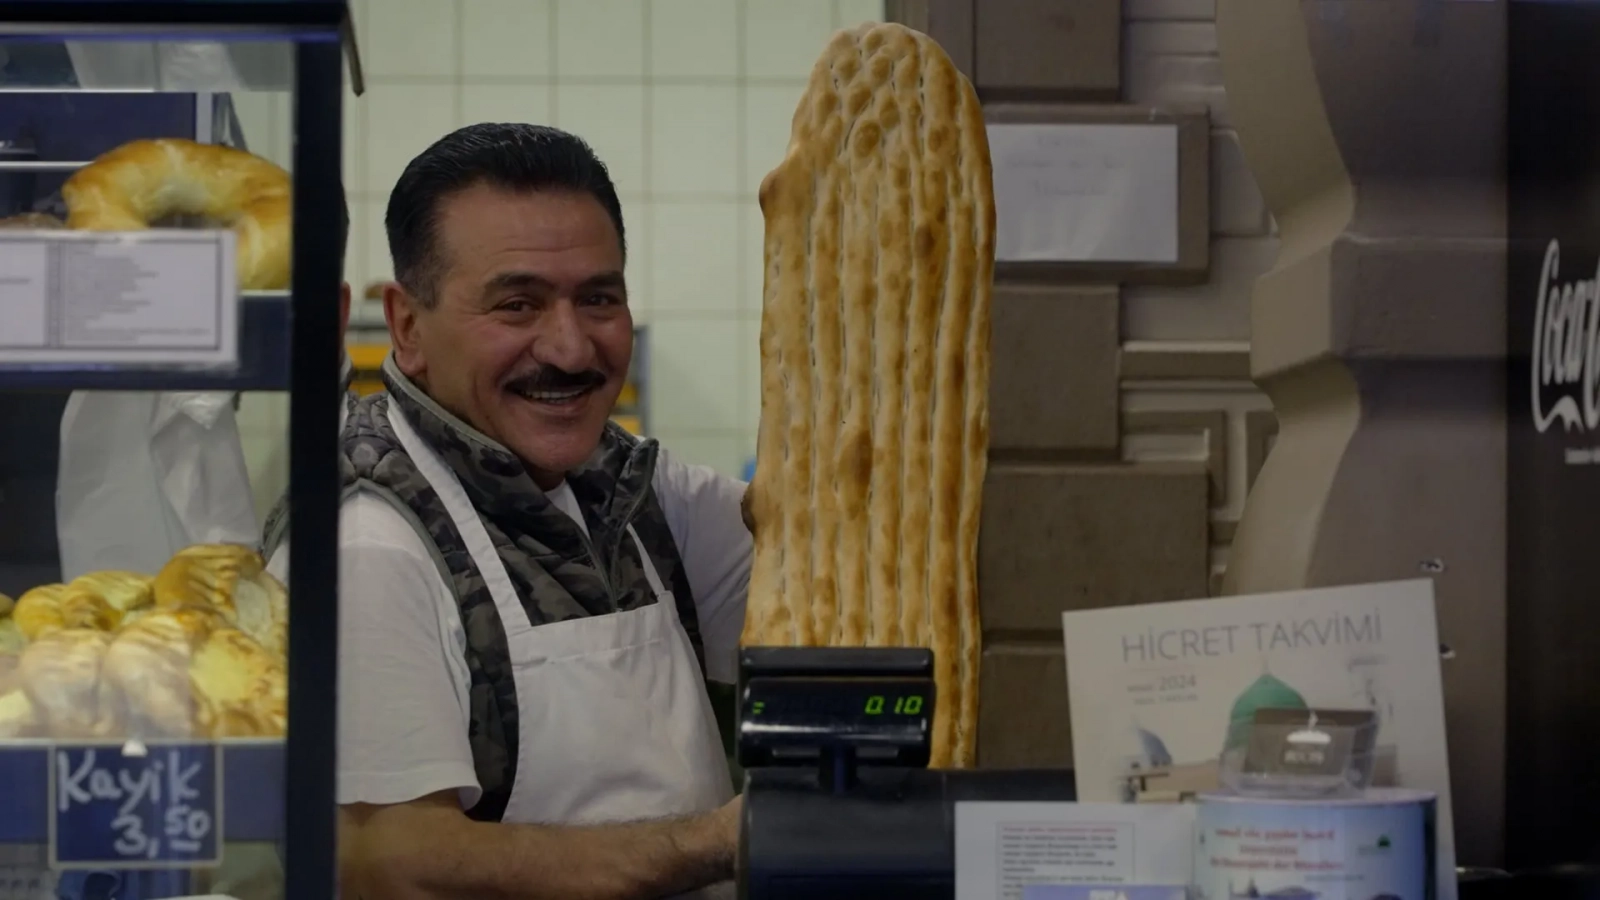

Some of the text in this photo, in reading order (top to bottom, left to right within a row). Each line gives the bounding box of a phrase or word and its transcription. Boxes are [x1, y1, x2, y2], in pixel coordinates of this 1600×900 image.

[1121, 608, 1383, 663] HİCRET TAKVİMİ
[1159, 674, 1197, 691] 2024
[57, 748, 202, 815] Kayik
